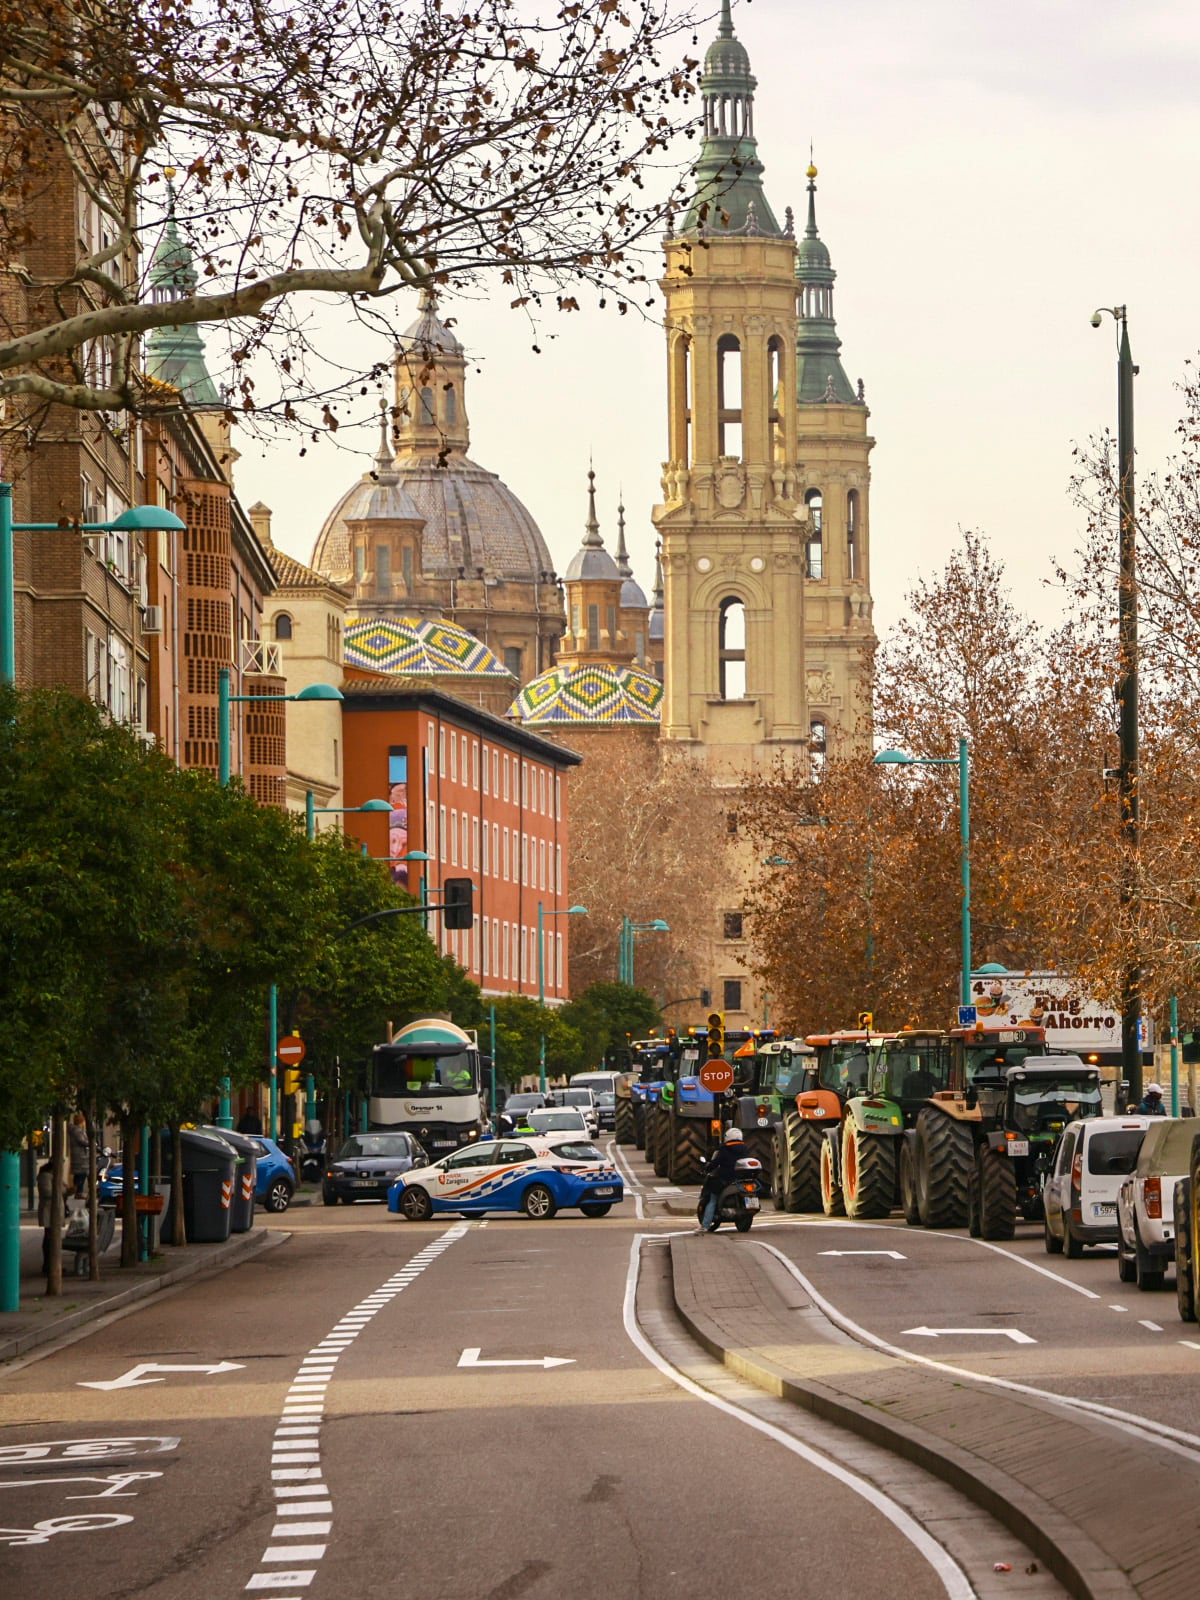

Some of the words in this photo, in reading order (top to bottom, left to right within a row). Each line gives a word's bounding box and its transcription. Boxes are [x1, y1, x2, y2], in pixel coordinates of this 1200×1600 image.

[1035, 996, 1081, 1016] King
[1045, 1013, 1116, 1030] Ahorro
[1014, 1030, 1026, 1042] 30
[703, 1071, 731, 1081] STOP
[445, 1178, 469, 1186] Zaragoza
